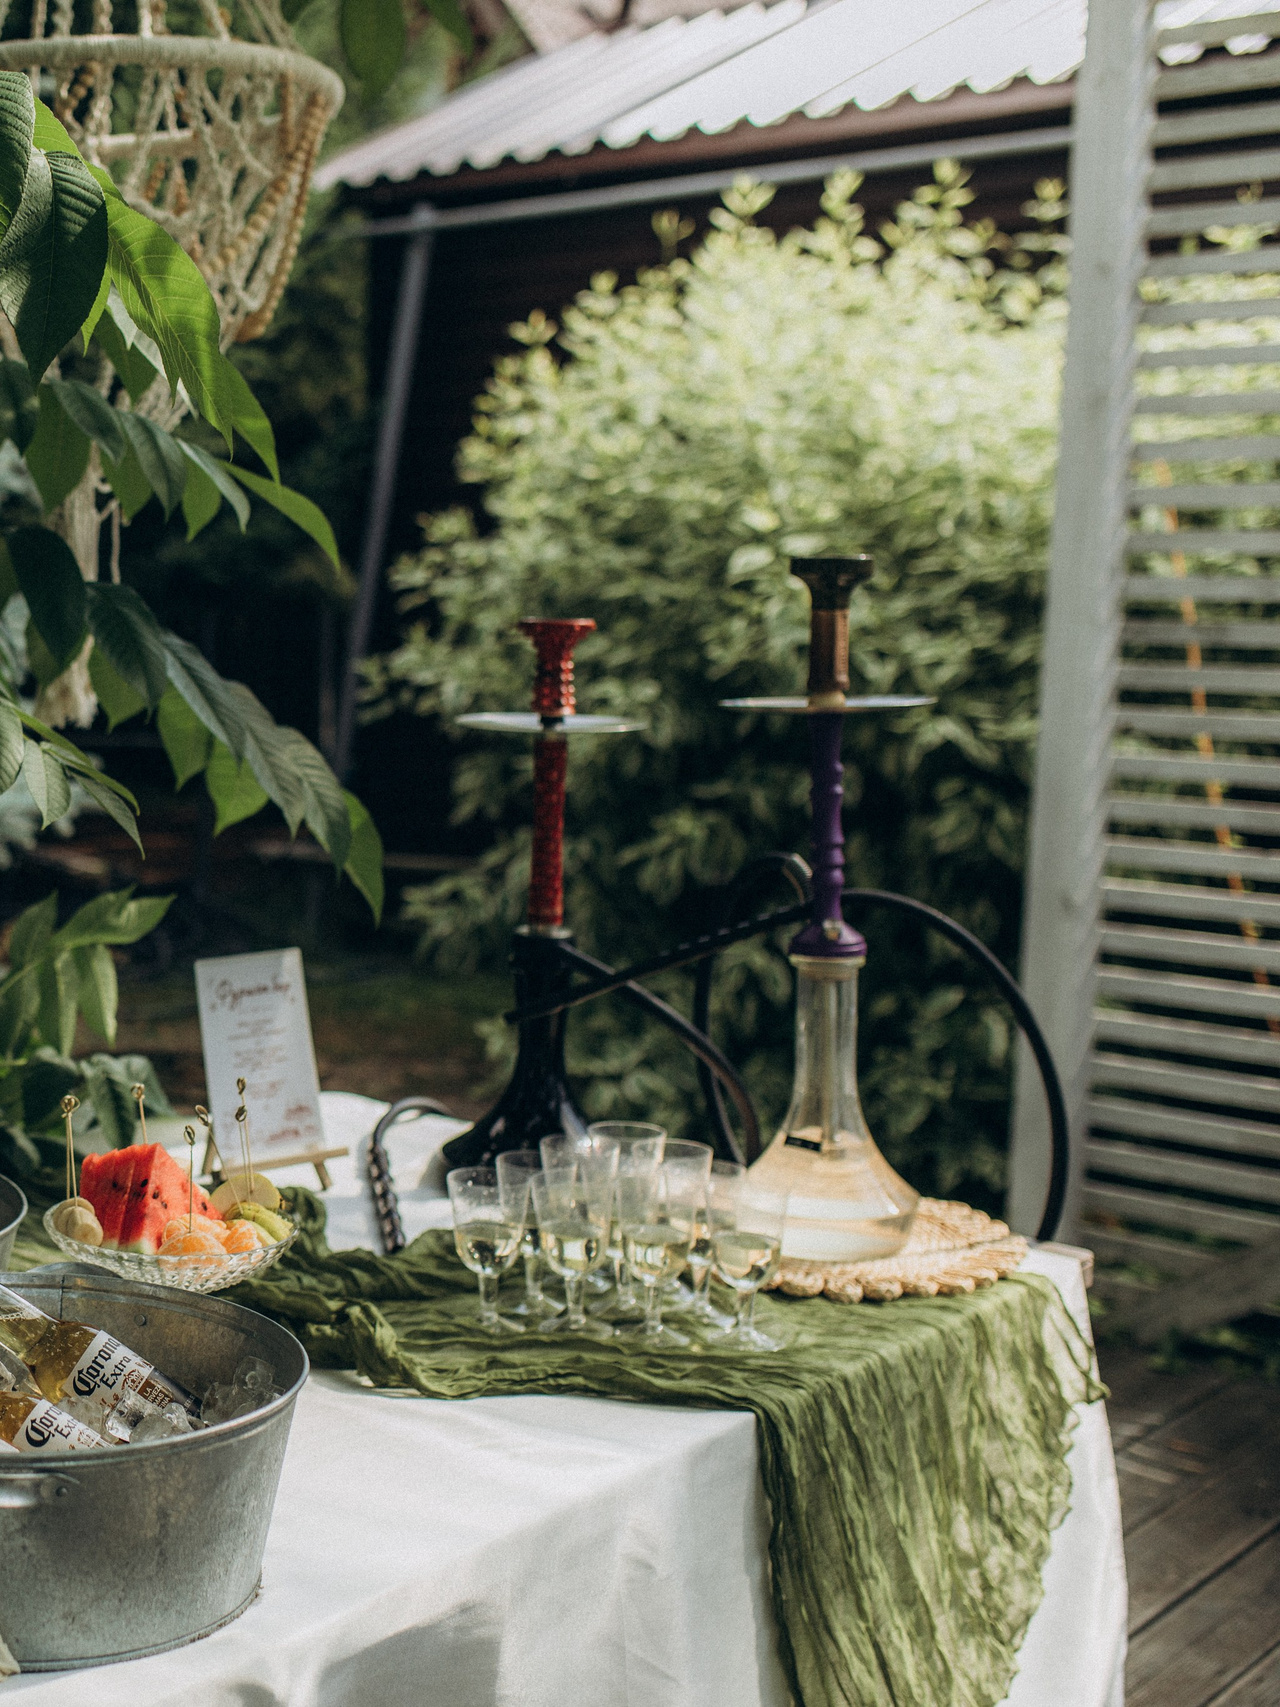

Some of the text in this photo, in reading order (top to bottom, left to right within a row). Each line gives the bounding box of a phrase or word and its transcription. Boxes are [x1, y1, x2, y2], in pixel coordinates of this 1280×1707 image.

[72, 1337, 122, 1397] Corona
[100, 1355, 131, 1390] Extra
[147, 1384, 162, 1402] RVEZA
